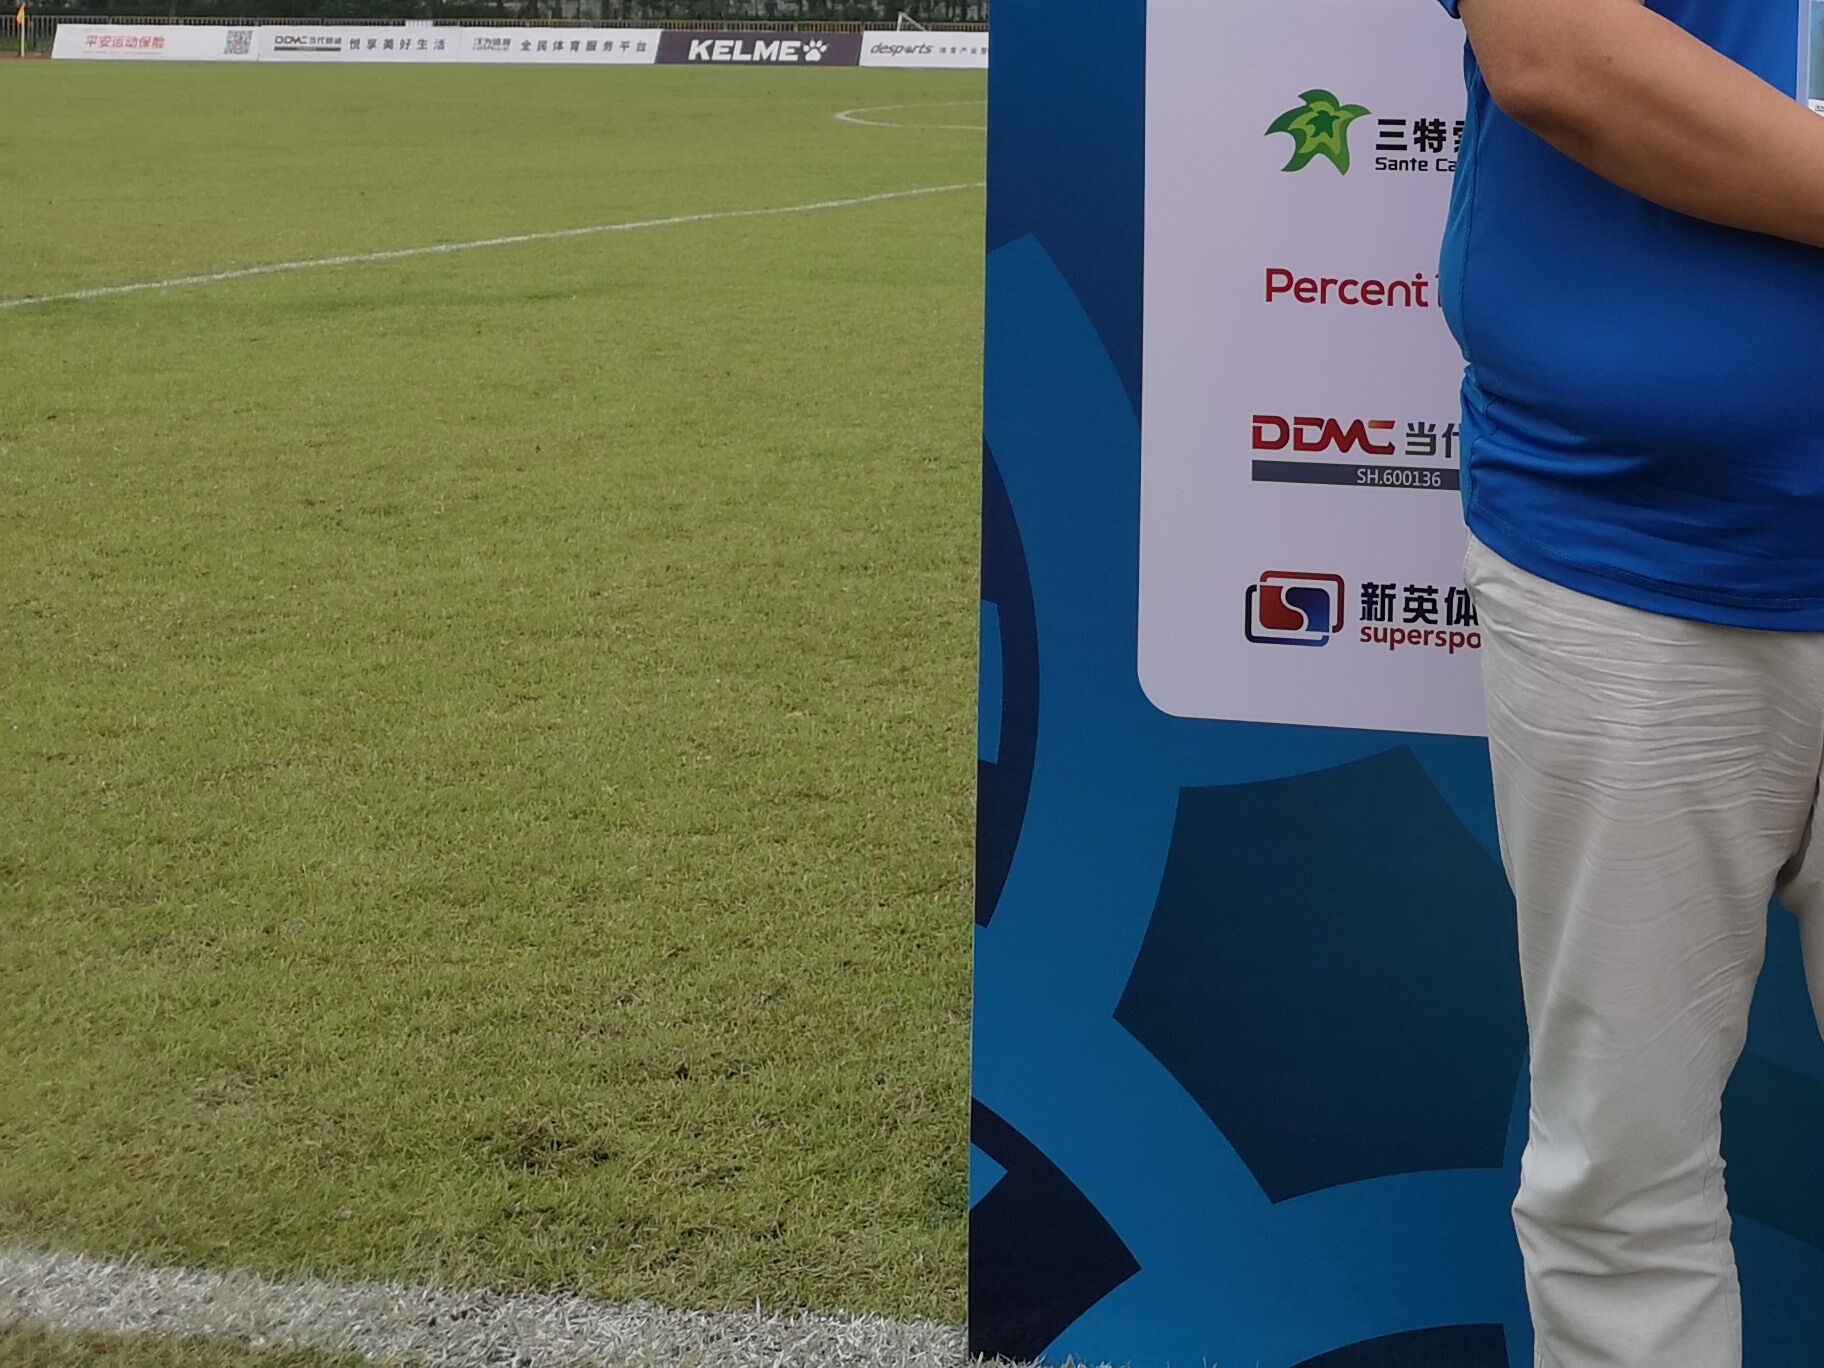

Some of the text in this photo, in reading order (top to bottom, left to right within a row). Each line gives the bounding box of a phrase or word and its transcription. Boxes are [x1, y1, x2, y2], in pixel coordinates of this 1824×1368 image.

[688, 39, 802, 61] KELME
[870, 43, 934, 56] desports
[1375, 157, 1428, 171] Sante
[1252, 414, 1396, 456] DDMC
[1356, 468, 1442, 487] SH.600136
